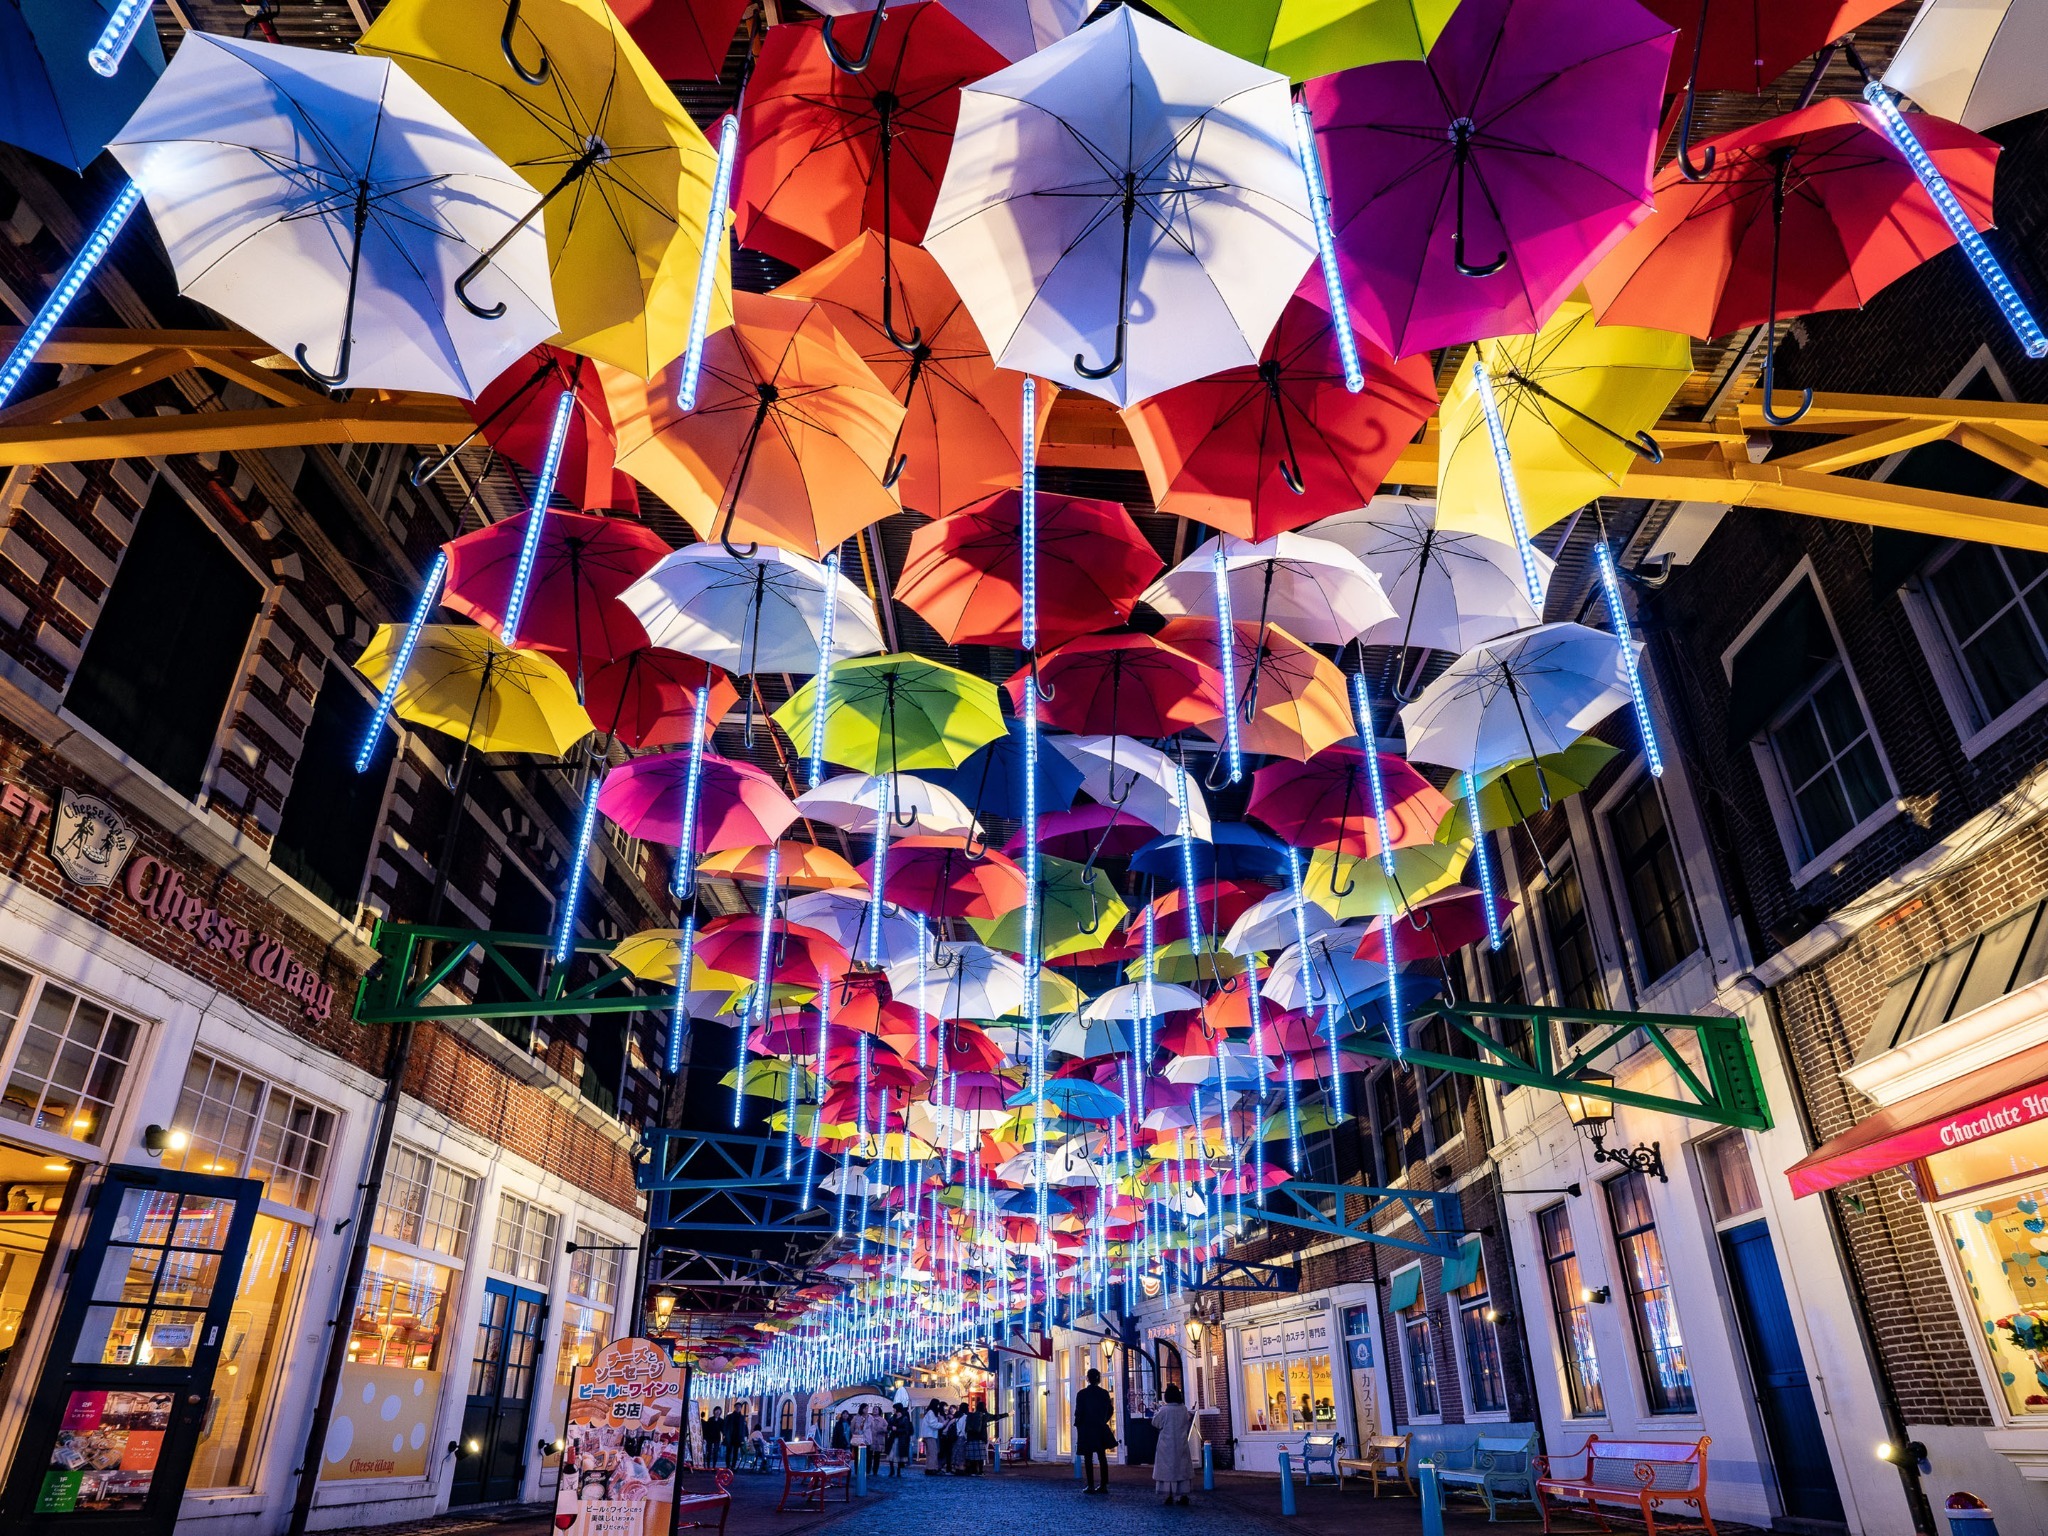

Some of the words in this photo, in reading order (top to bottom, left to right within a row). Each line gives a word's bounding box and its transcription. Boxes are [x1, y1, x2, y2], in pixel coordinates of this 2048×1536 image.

[64, 801, 104, 819] Cheese
[127, 855, 249, 961] Cheese
[250, 932, 334, 1021] Waag
[1940, 1107, 2022, 1146] Chocolate
[607, 1347, 657, 1366] チーズと
[596, 1363, 664, 1382] ソーセージ
[579, 1381, 679, 1399] ビールにワインの
[613, 1402, 641, 1417] お店
[349, 1458, 374, 1474] Cheese
